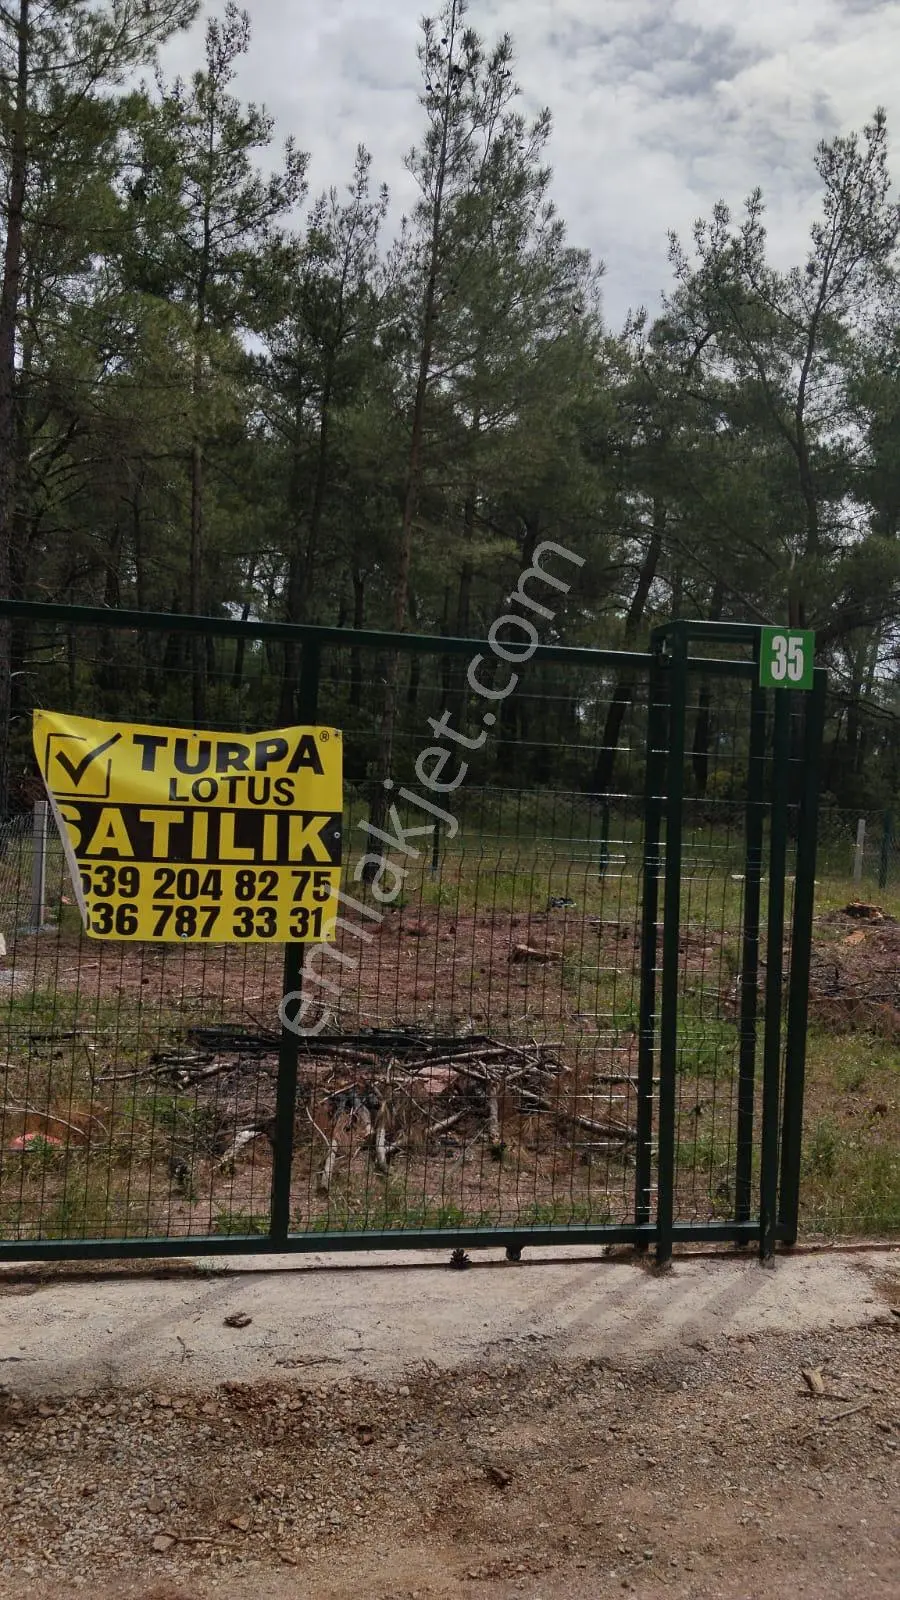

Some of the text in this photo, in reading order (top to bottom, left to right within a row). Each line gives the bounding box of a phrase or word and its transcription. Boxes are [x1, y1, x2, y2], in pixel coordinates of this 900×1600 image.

[771, 635, 804, 681] 35
[168, 775, 295, 806] LOTUS
[152, 867, 223, 901] 204
[234, 870, 279, 902] 82
[291, 870, 331, 902] 75
[86, 901, 323, 938] 36 787 33 31
